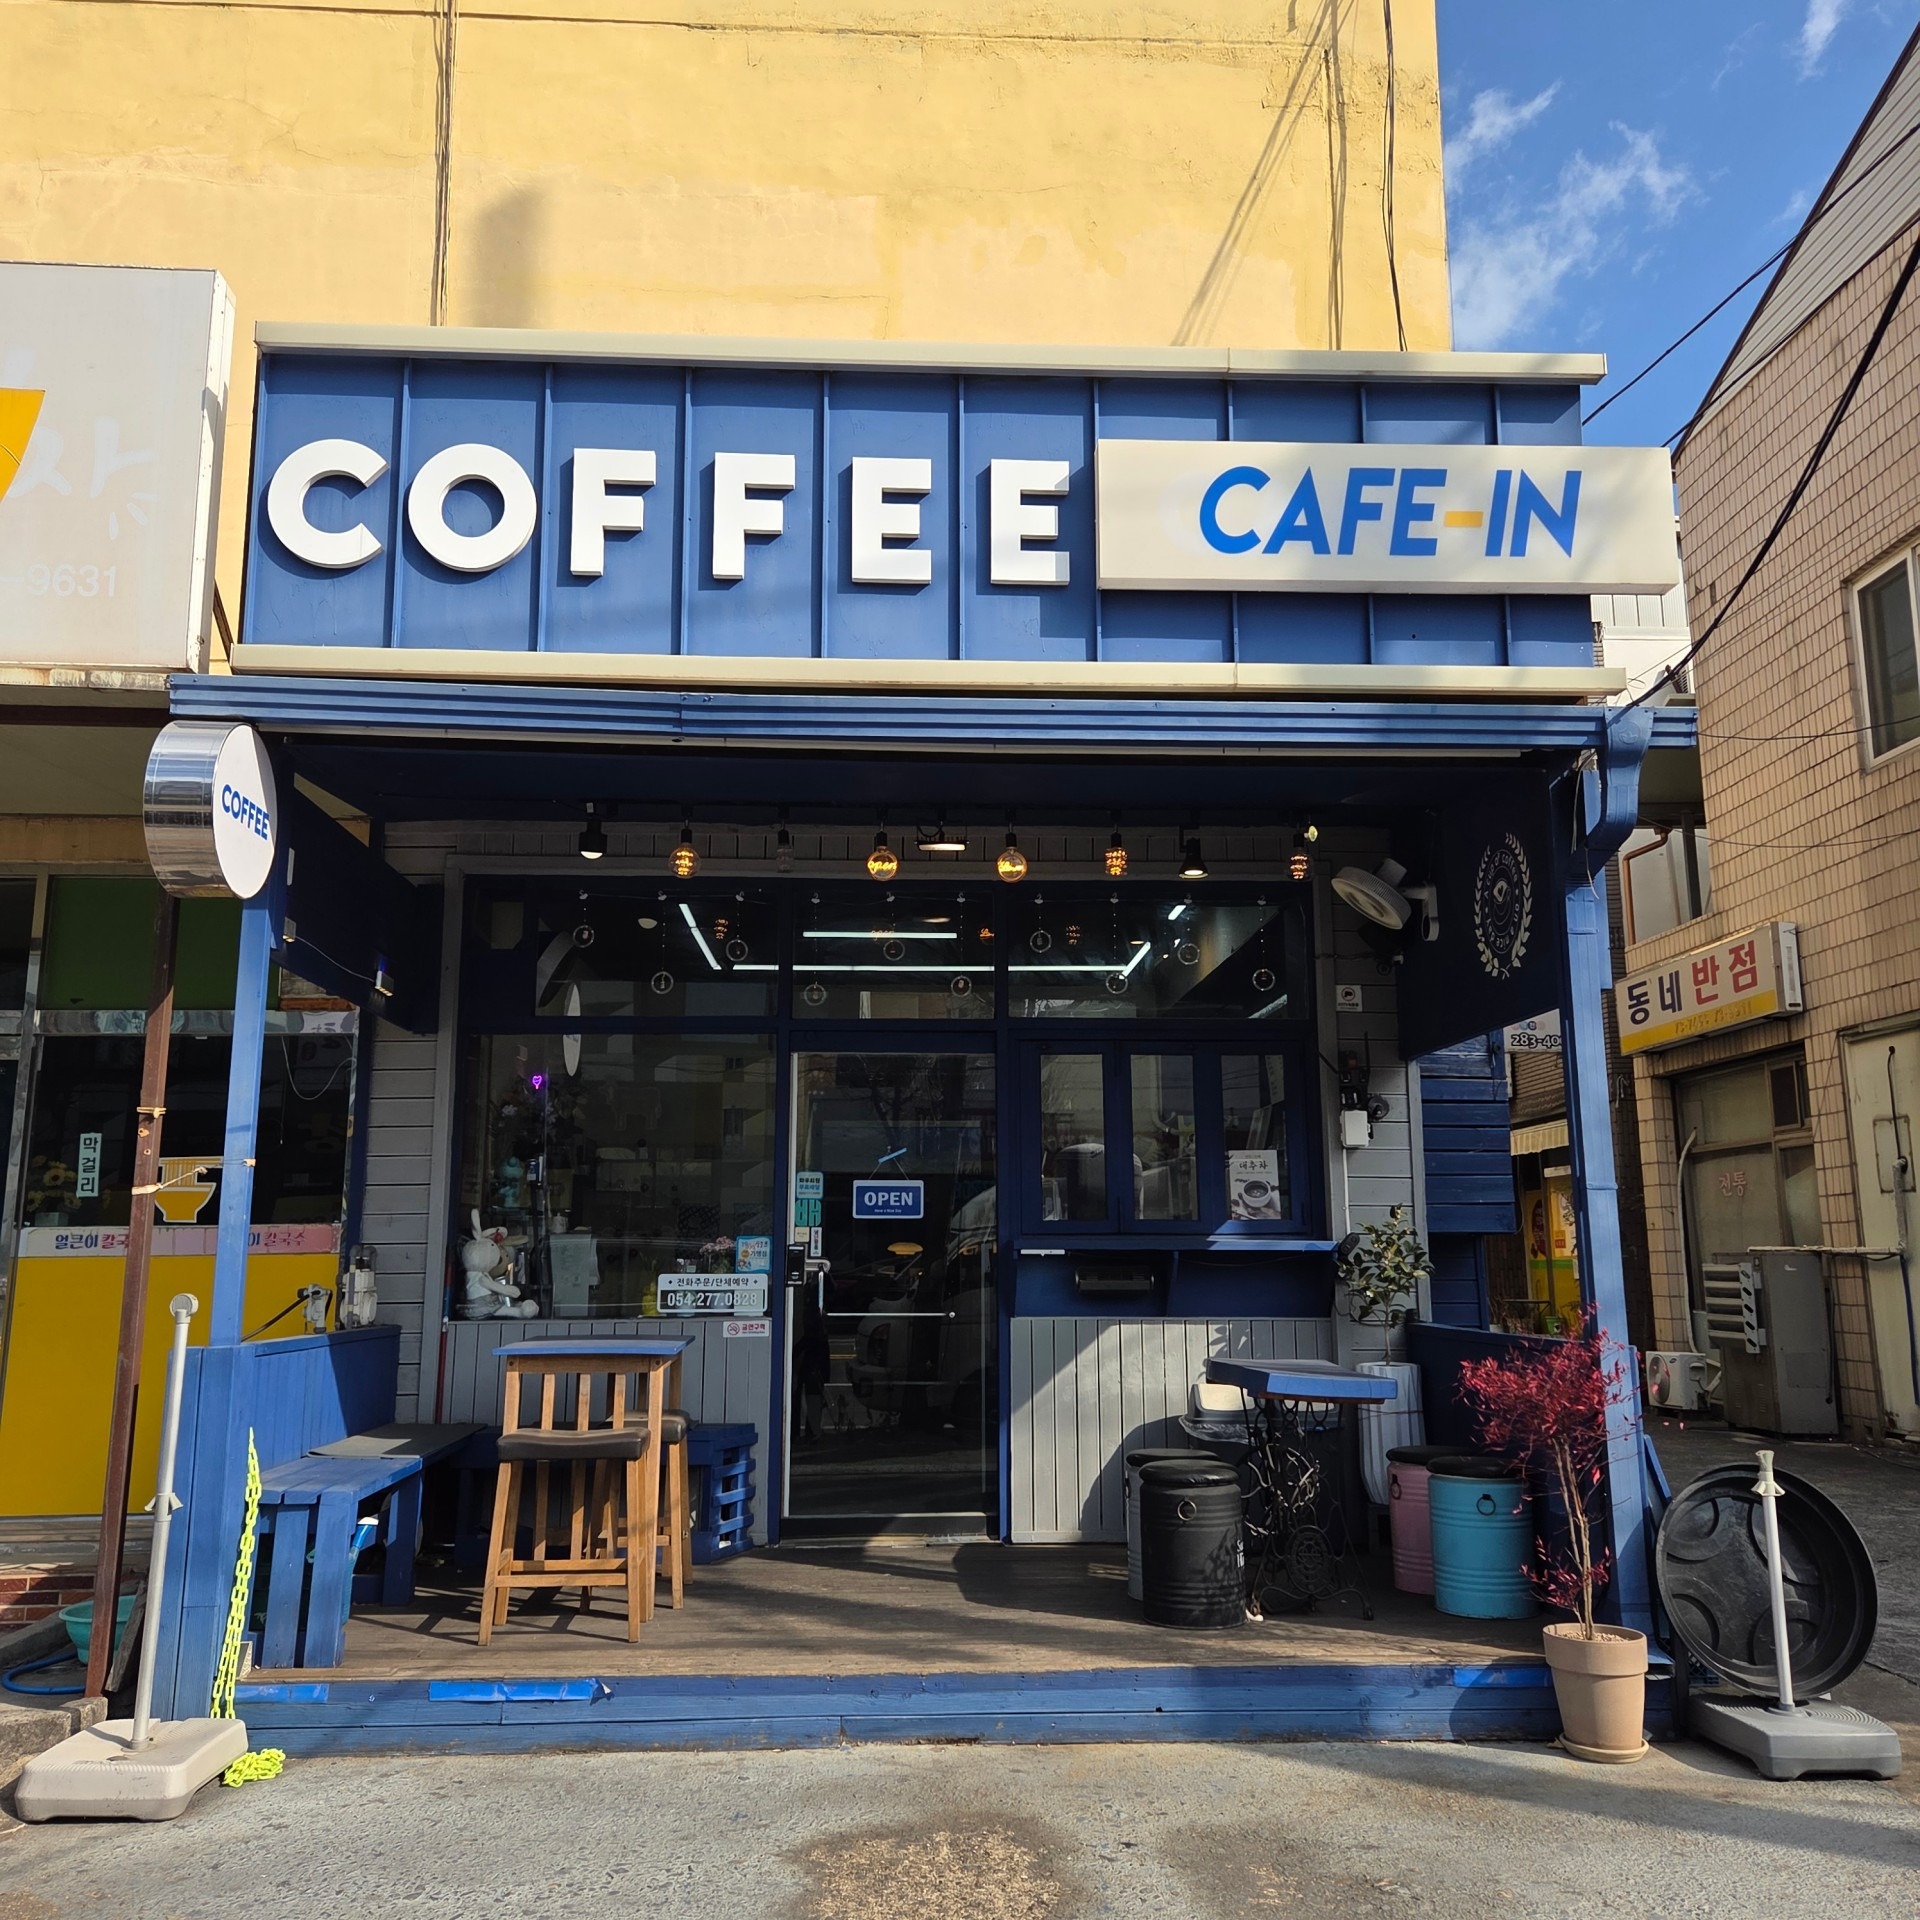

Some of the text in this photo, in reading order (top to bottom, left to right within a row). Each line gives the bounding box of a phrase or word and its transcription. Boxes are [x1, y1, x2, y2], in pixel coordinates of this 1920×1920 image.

[267, 438, 1070, 586] COFFEE
[1199, 465, 1583, 558] CAFE-IN
[222, 784, 270, 840] COFFEE
[1510, 1032, 1562, 1049] 283-40
[81, 1137, 99, 1193] 막걸리
[1719, 1171, 1746, 1197] 전통
[864, 1191, 913, 1206] OPEN
[55, 1233, 129, 1249] 얼큰이 칼국
[264, 1232, 305, 1246] 칼국수
[677, 1278, 749, 1287] 전화주문/단체예약
[667, 1292, 757, 1306] 054.277.0828
